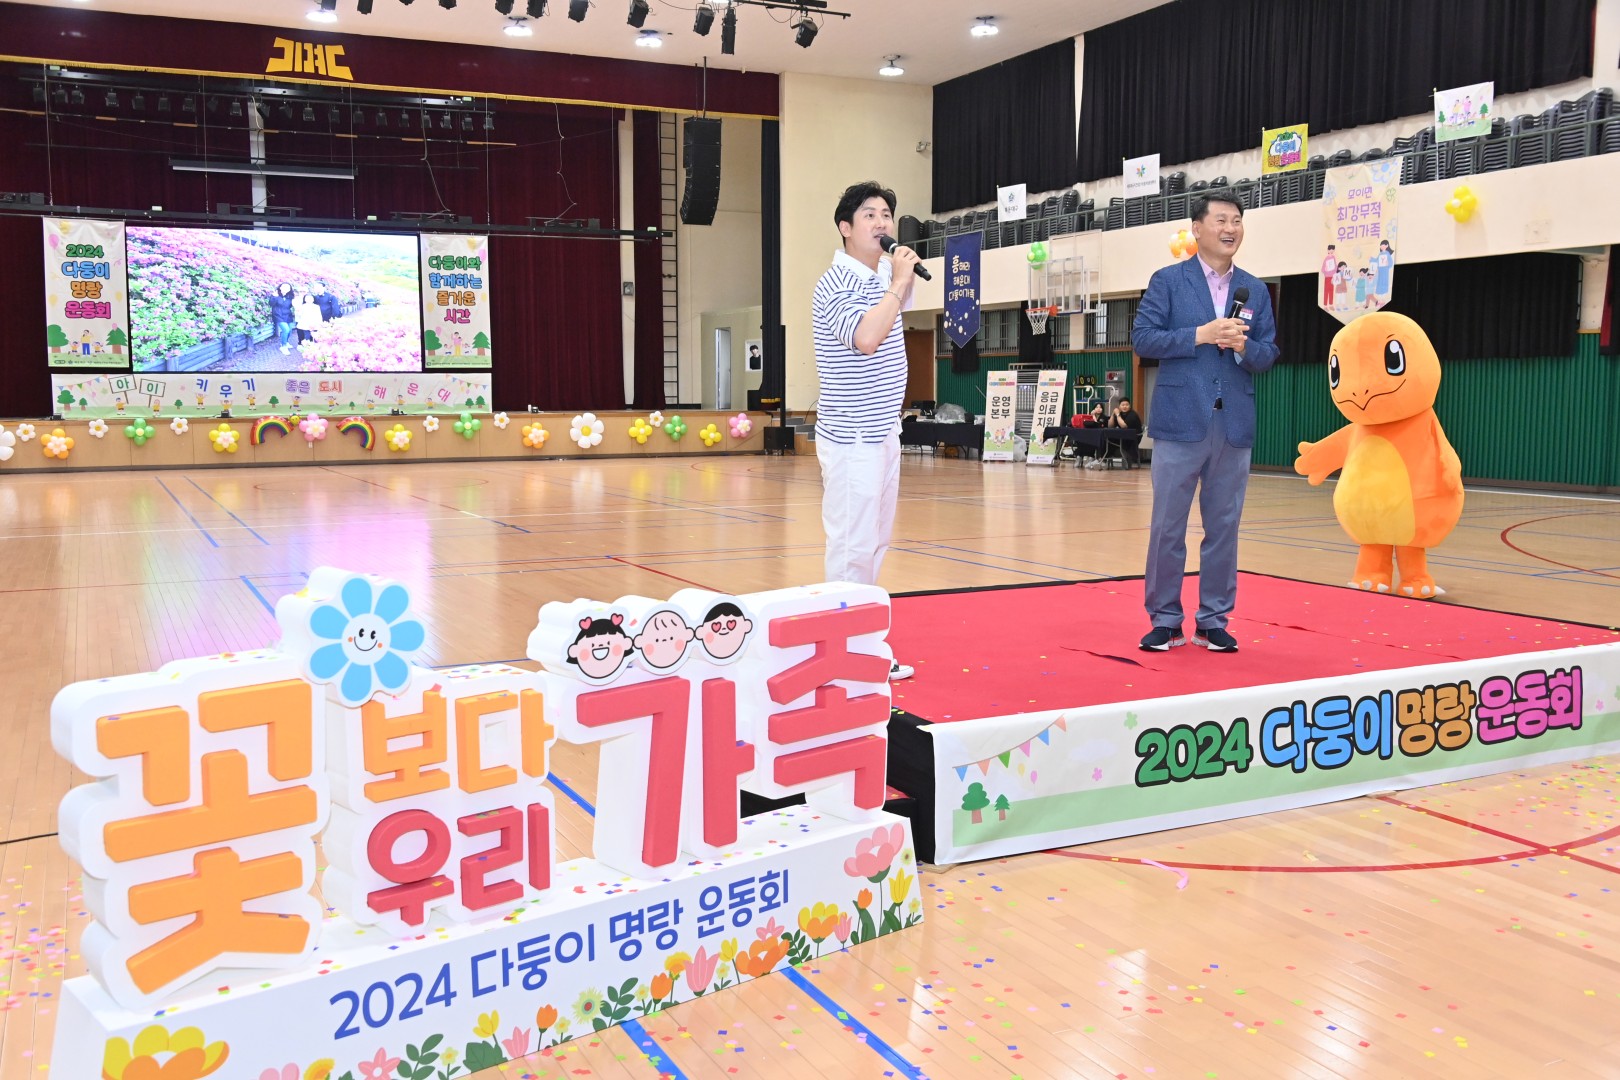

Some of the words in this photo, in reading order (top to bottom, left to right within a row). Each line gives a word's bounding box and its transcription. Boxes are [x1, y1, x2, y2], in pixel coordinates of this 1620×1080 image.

[1347, 186, 1373, 200] 모이면
[1337, 201, 1382, 222] 최강무적
[1336, 222, 1381, 242] 우리가족
[65, 244, 104, 258] 2024
[61, 261, 110, 279] 다둥이
[428, 255, 482, 271] 다둥이와
[428, 272, 482, 289] 함께하는
[953, 275, 970, 286] 해운대
[70, 281, 103, 299] 명랑
[436, 290, 476, 306] 즐거운
[949, 289, 975, 301] 다둥이가족
[65, 301, 111, 319] 운동회
[444, 308, 471, 324] 시간
[285, 379, 310, 394] 좋은
[318, 380, 342, 393] 도시
[992, 396, 1010, 407] 운영
[1041, 392, 1059, 403] 응급
[991, 409, 1010, 419] 본부
[1038, 404, 1056, 415] 의료
[1037, 417, 1055, 428] 지원
[1135, 717, 1253, 788] 2024
[1259, 691, 1393, 773] 다둥이
[1394, 681, 1477, 757] 명랑
[1476, 665, 1583, 745] 운동회
[367, 803, 550, 927] 우리
[576, 602, 891, 868] 가족
[329, 963, 457, 1040] 2024
[470, 923, 596, 998] 다둥이
[608, 899, 684, 962] 명랑
[697, 868, 790, 939] 운동회
